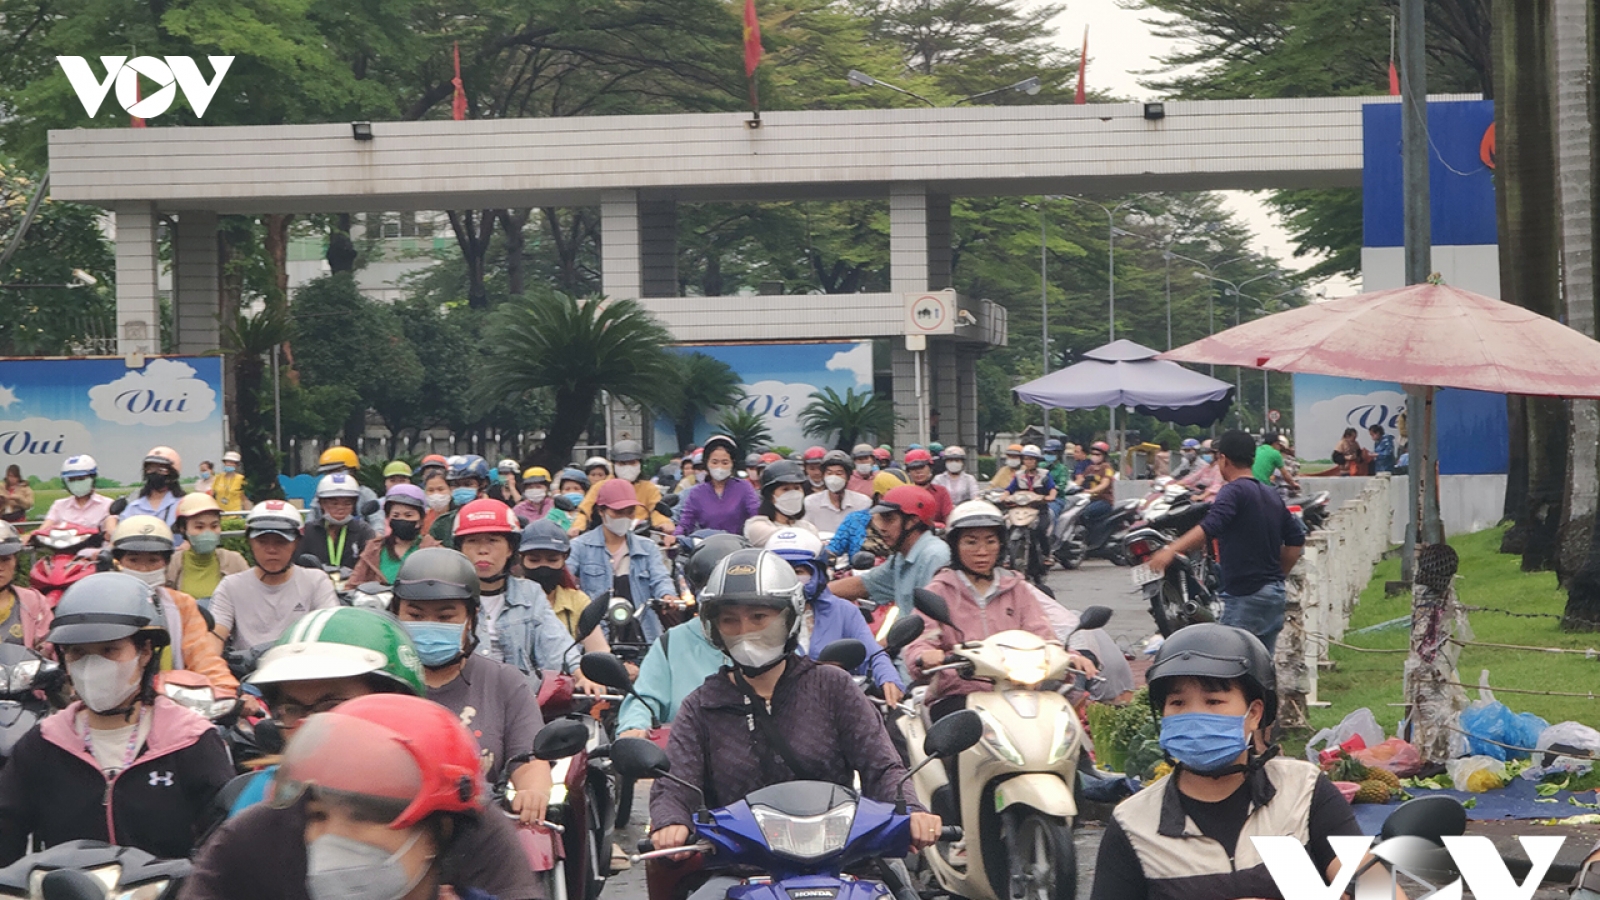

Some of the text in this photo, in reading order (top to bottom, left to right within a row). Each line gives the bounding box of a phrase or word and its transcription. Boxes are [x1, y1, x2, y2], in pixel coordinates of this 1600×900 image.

[114, 389, 191, 413] Vui
[0, 430, 65, 455] Vui
[794, 890, 834, 898] HONDA
